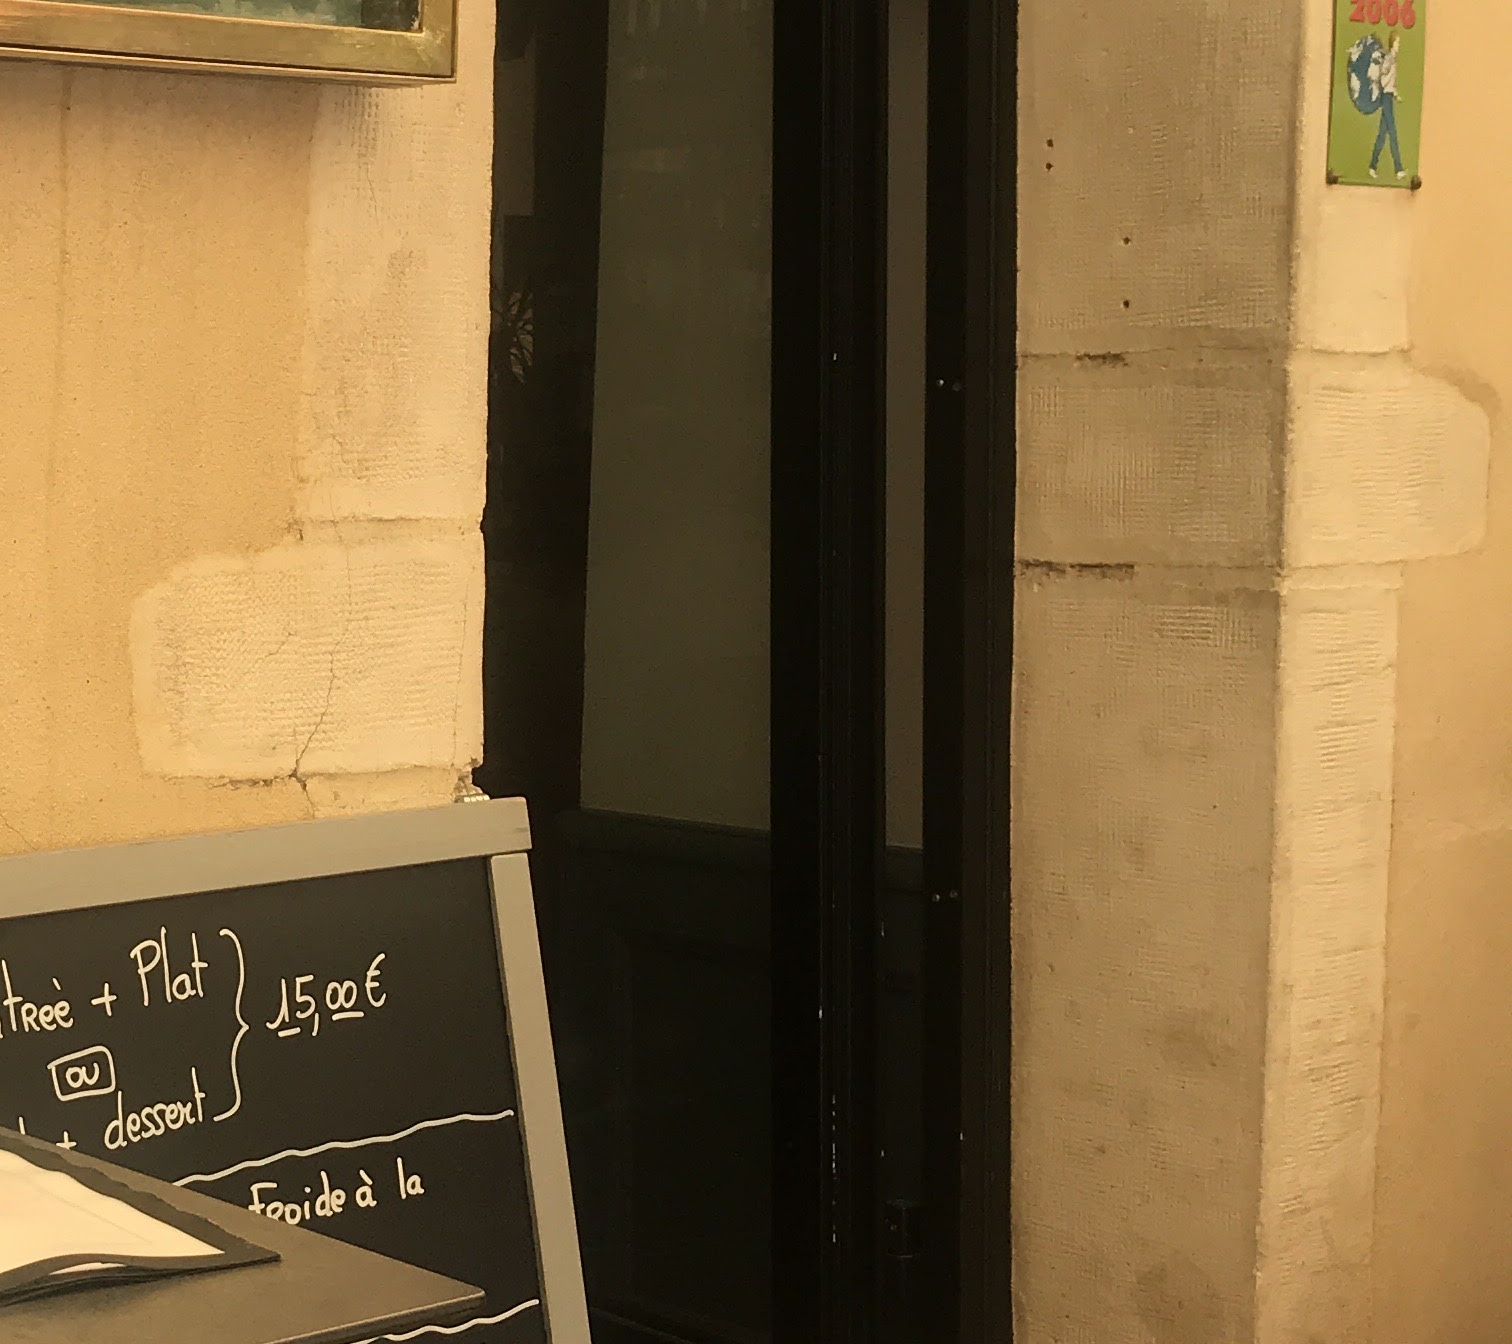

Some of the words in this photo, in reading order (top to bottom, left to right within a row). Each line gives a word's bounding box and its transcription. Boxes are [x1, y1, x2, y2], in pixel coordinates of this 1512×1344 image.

[91, 983, 118, 1017] +
[129, 926, 208, 1006] Plat
[104, 1066, 206, 1150] dessert
[355, 1169, 377, 1208] à
[396, 1157, 425, 1199] la
